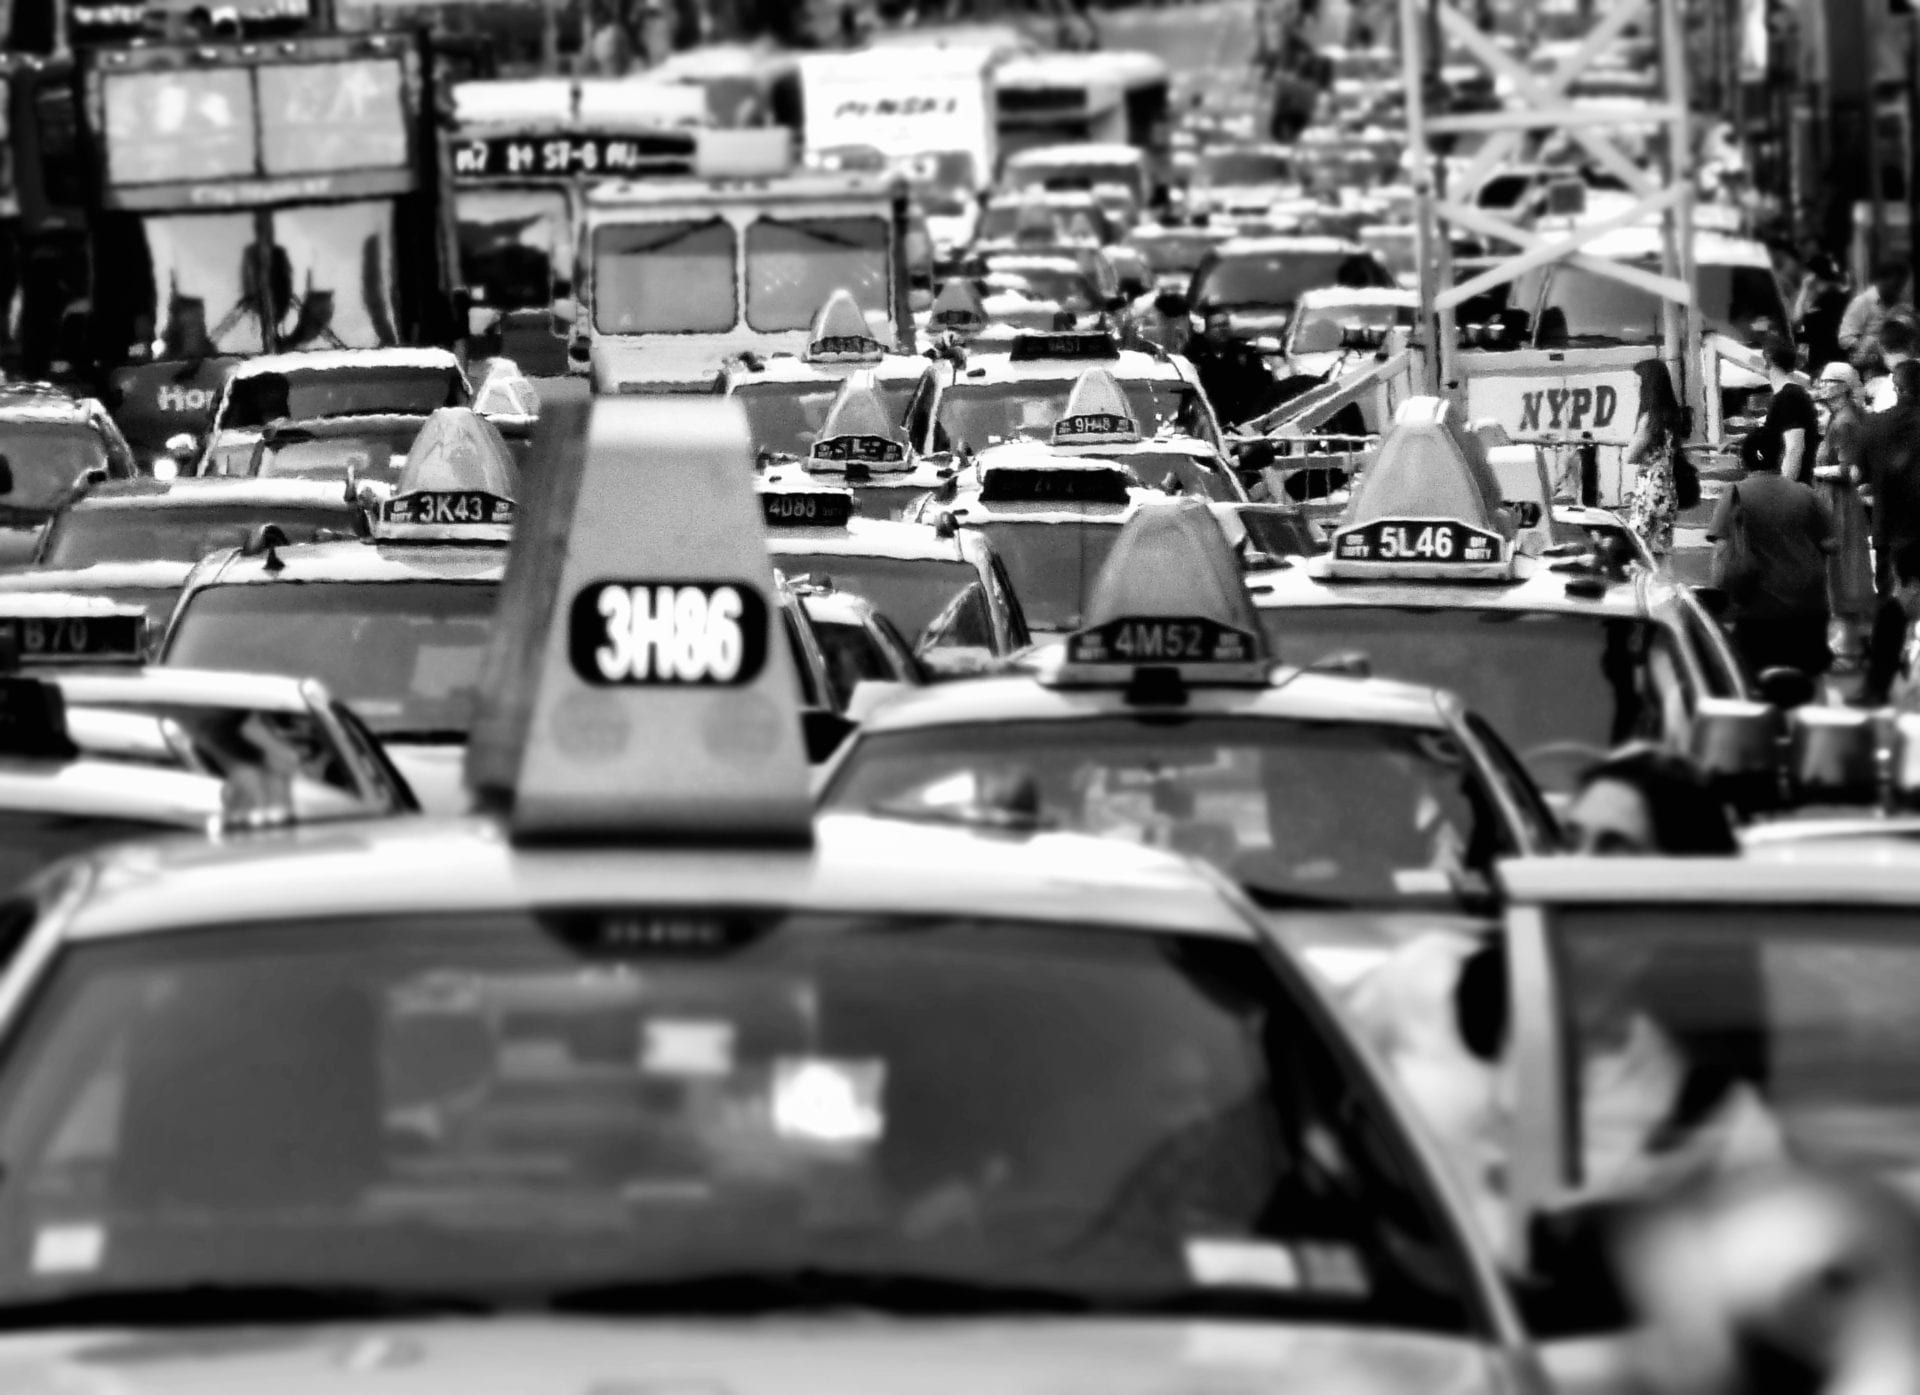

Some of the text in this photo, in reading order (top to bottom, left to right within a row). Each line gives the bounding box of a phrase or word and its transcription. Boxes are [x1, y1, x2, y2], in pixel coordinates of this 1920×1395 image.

[1520, 385, 1617, 431] NYPD
[419, 494, 482, 522] 3K43
[1379, 526, 1453, 559] 5L46
[595, 583, 744, 682] 3H86
[1115, 623, 1202, 657] 4M52
